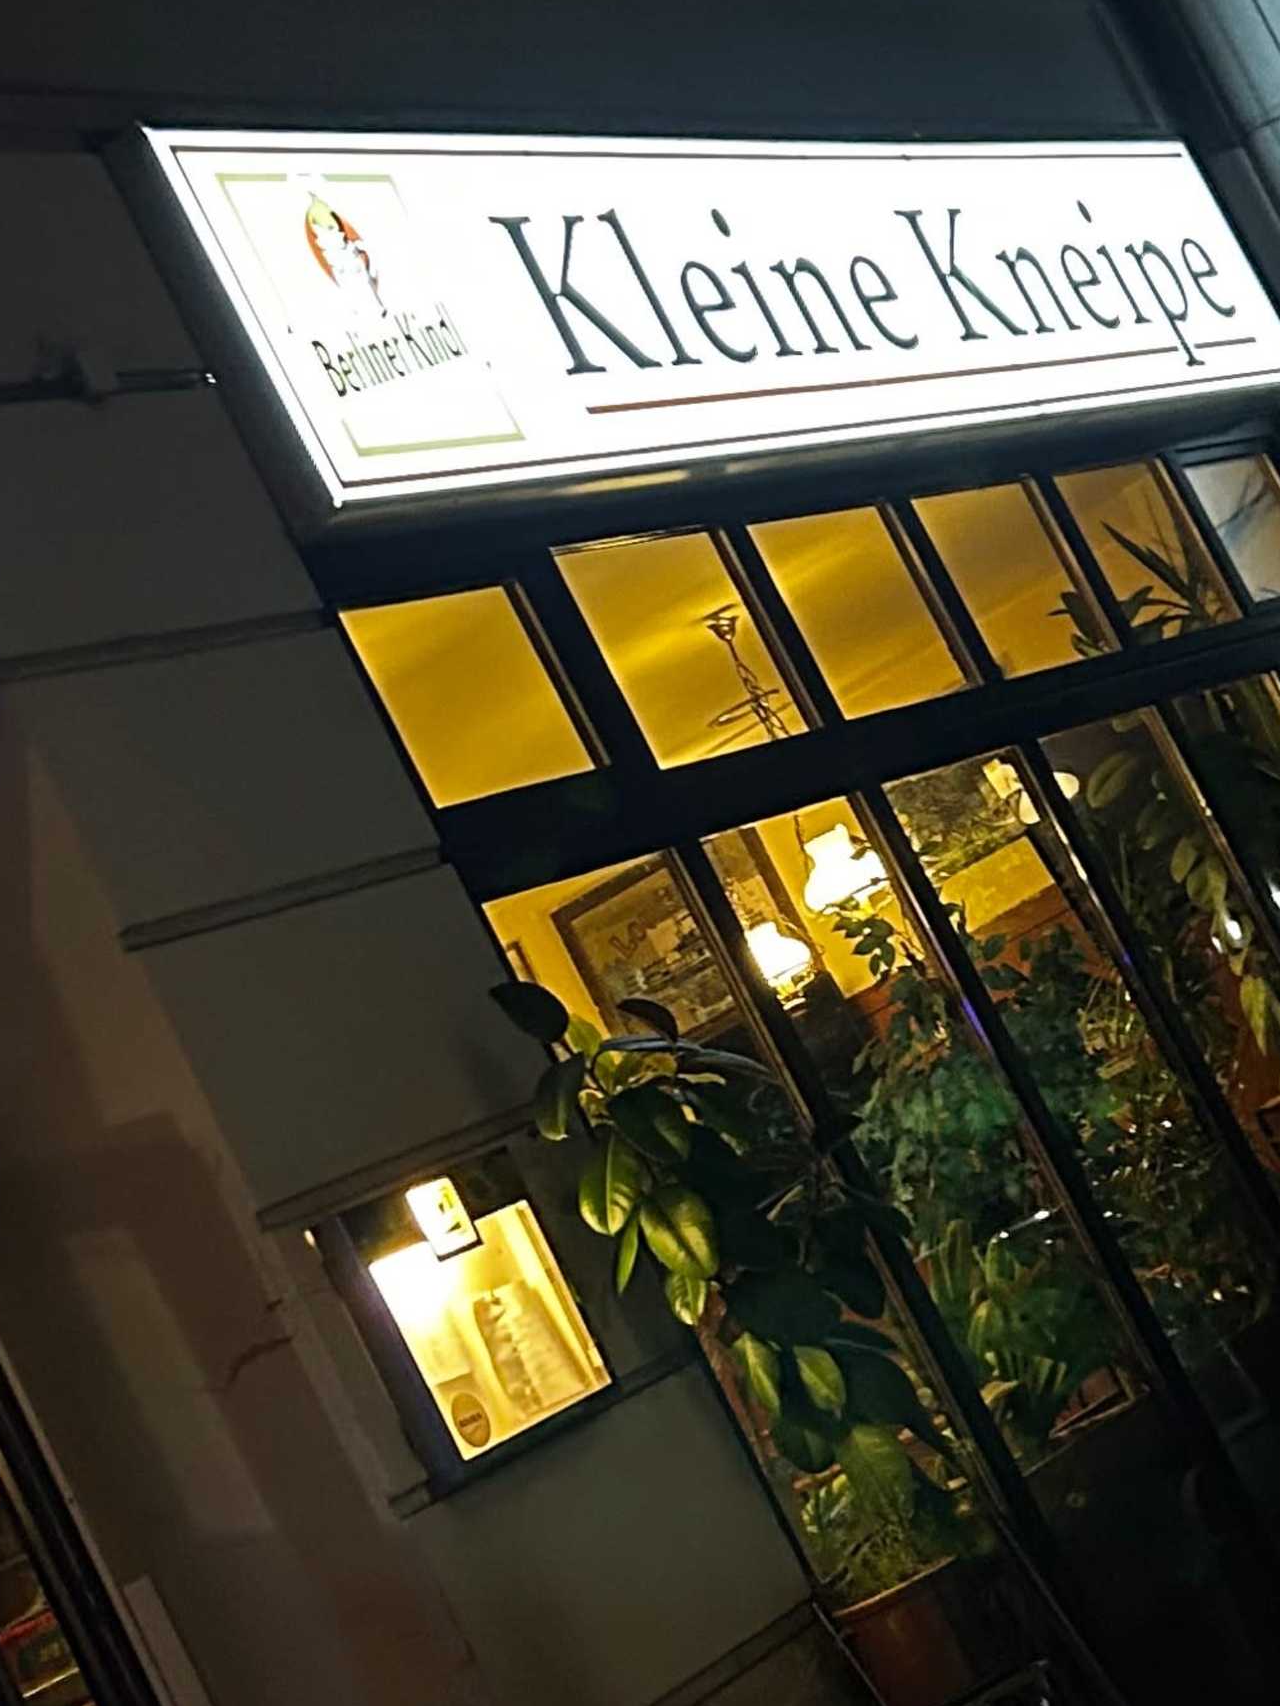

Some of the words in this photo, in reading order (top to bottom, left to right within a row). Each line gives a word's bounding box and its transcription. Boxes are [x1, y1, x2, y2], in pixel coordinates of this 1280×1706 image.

[311, 330, 412, 398] Berliner
[393, 300, 469, 371] Kindl
[487, 207, 920, 377] Kleine
[892, 199, 1237, 367] Kneipe
